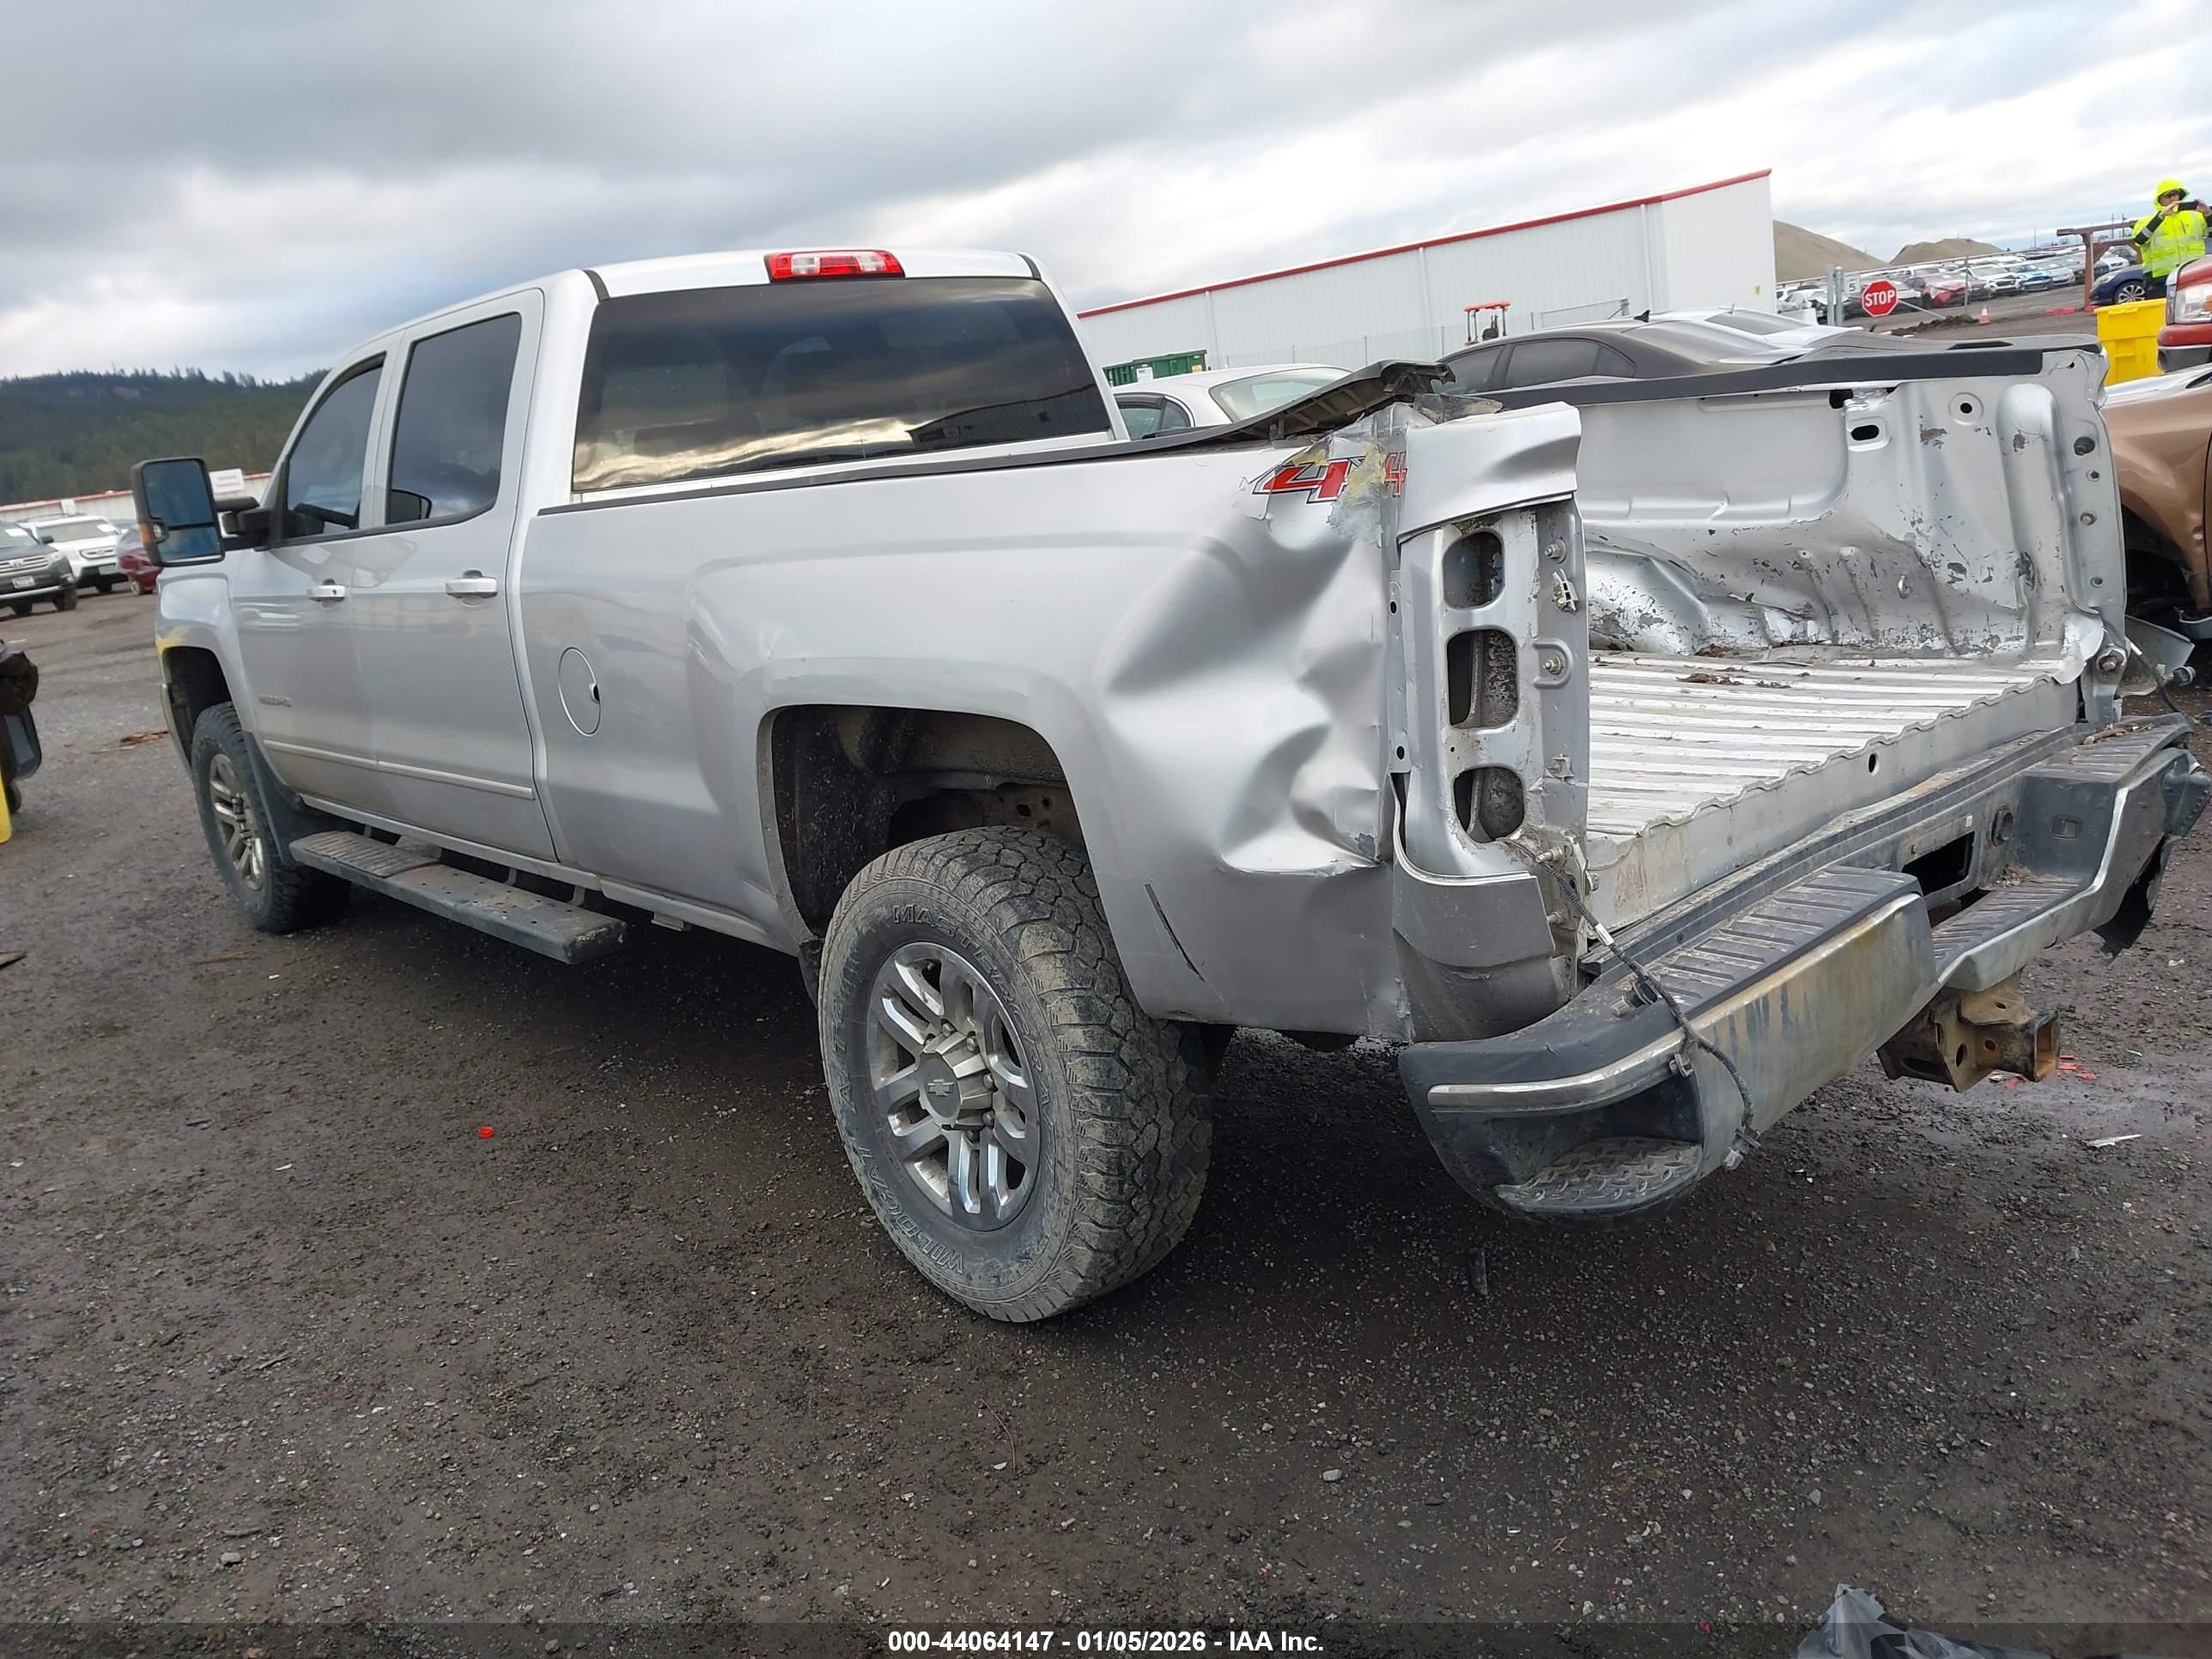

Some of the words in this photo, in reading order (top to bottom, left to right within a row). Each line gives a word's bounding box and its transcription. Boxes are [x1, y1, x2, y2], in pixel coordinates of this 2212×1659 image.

[1849, 283, 1856, 292] 5
[1864, 289, 1895, 307] STOP
[1252, 452, 1408, 504] 44
[855, 1146, 963, 1274] WILDCAT
